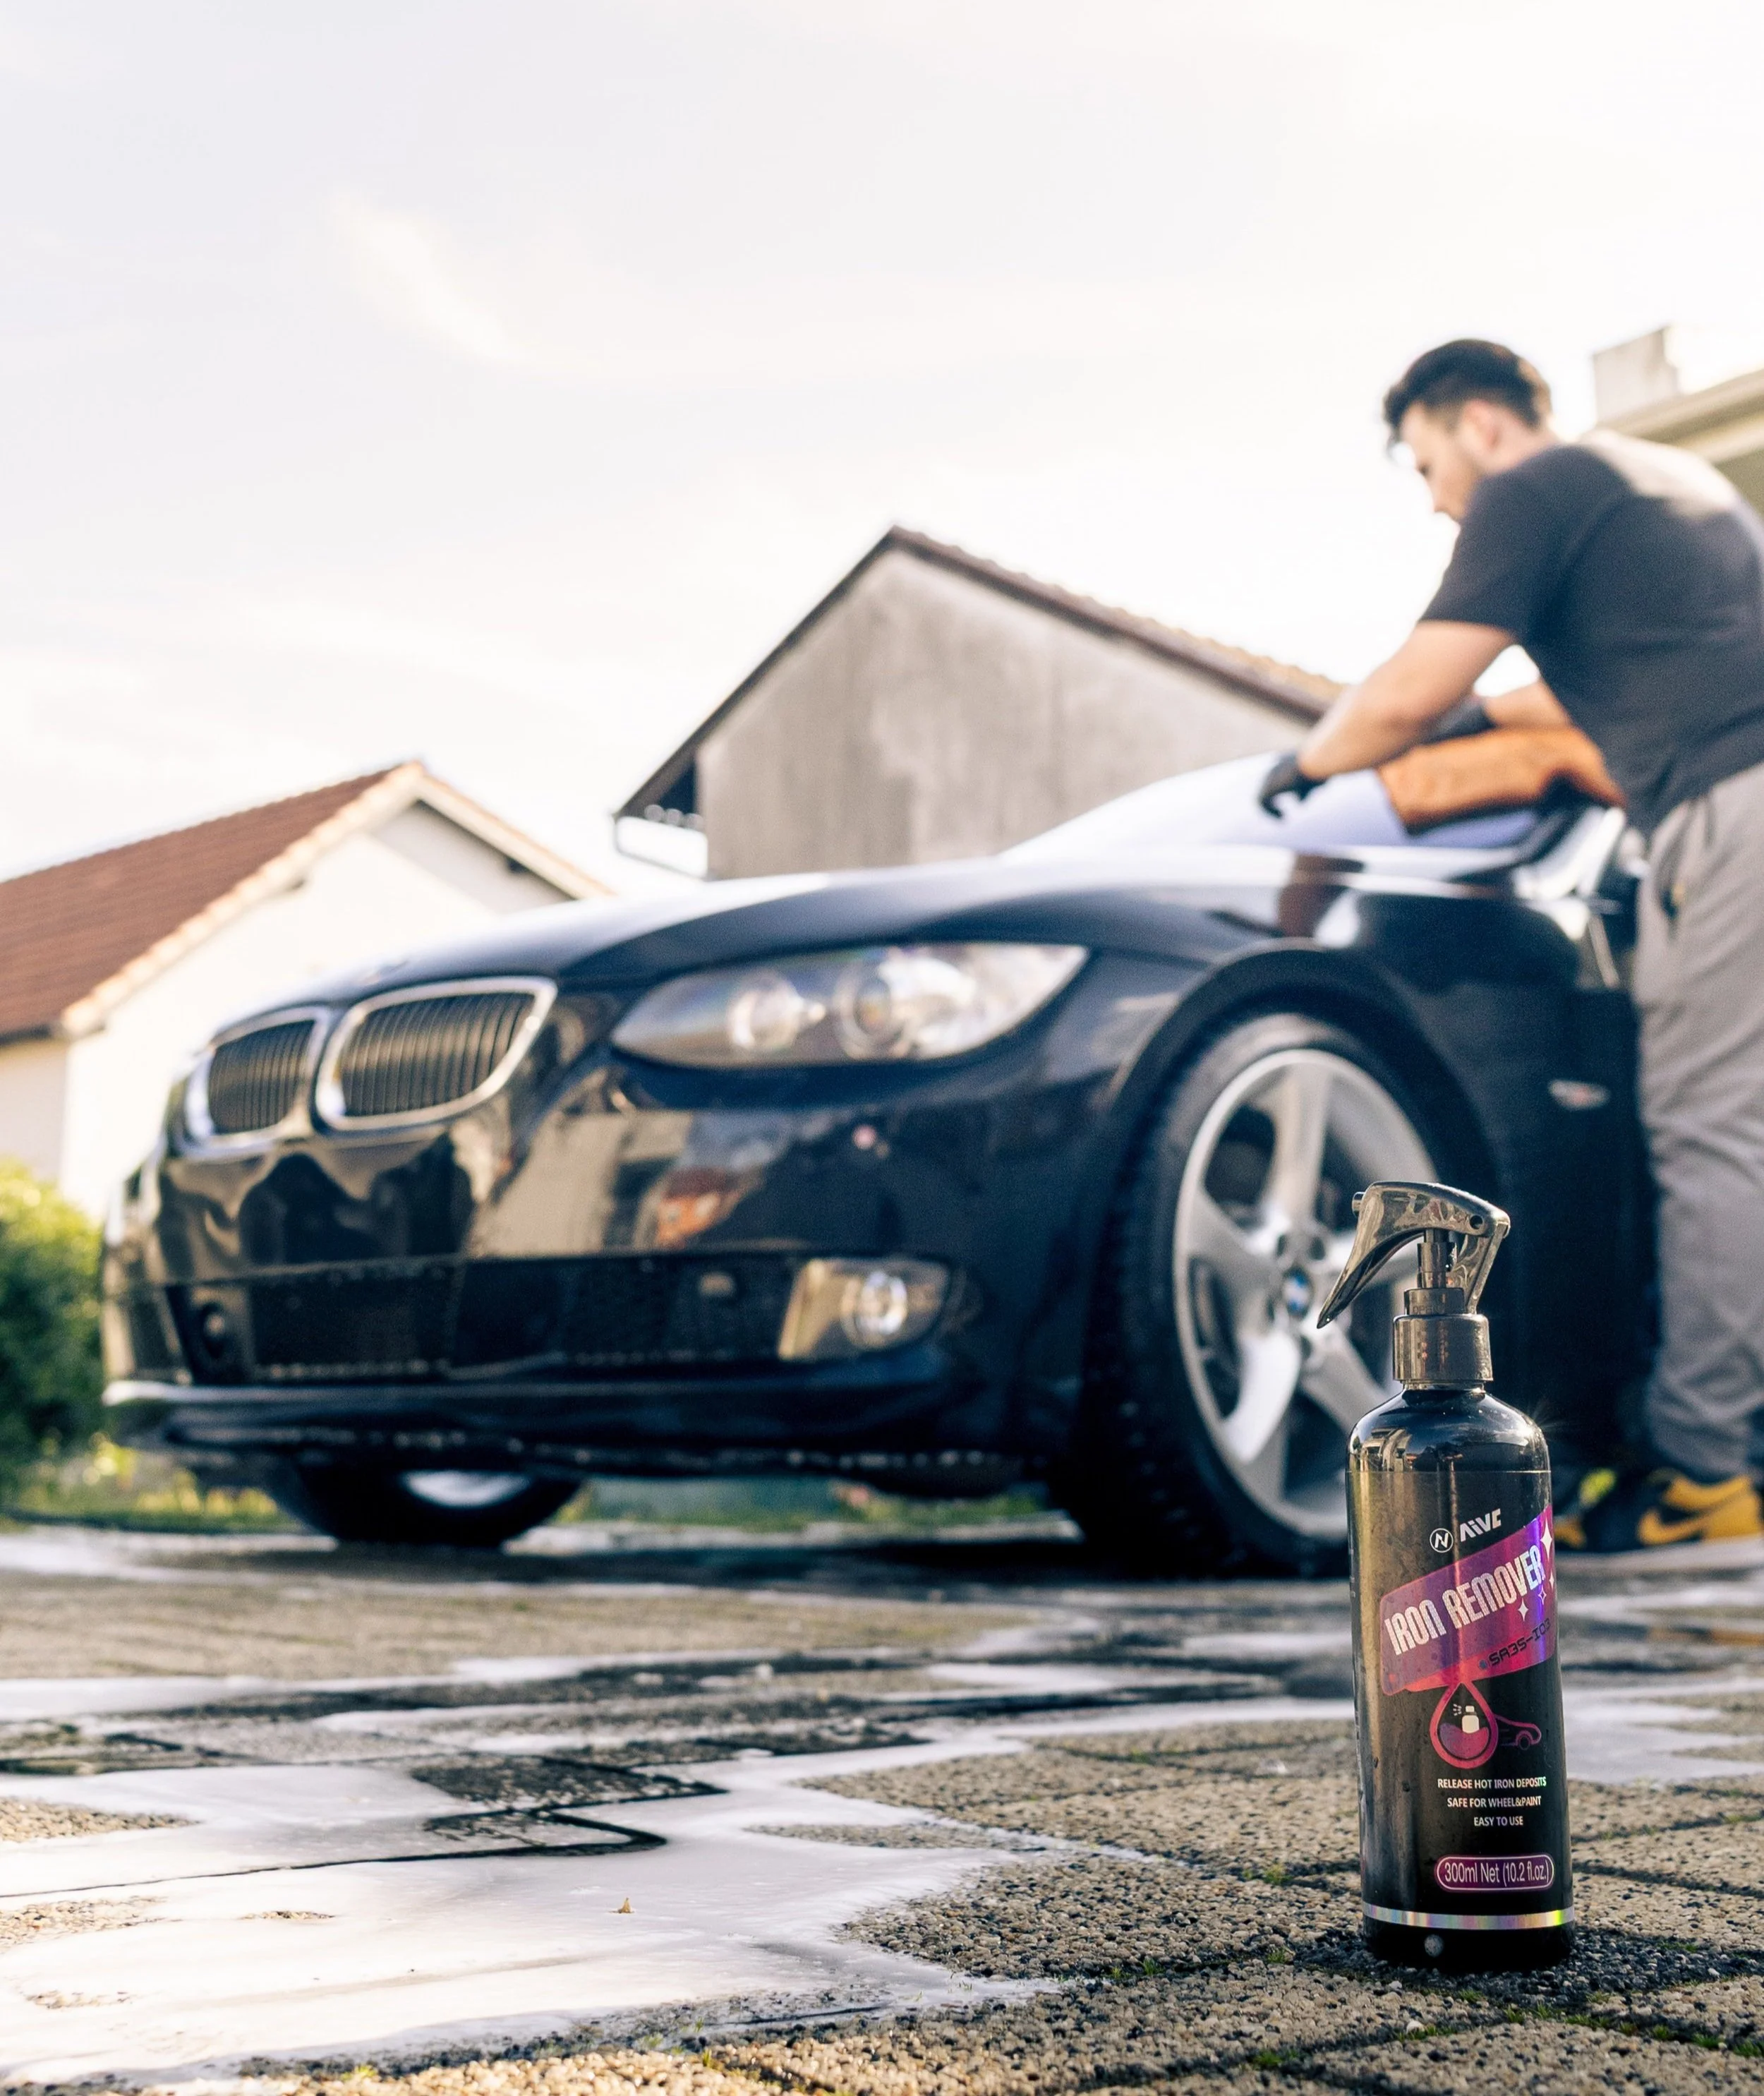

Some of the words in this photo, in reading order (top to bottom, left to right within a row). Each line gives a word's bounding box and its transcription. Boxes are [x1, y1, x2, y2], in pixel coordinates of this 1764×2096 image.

[1384, 1599, 1447, 1656] IRON
[1442, 1544, 1545, 1630] REMOVER
[1437, 1778, 1473, 1789] RELEASE
[1474, 1779, 1492, 1789] HOT
[1494, 1778, 1515, 1789] IRON
[1516, 1776, 1547, 1788] DEPOSITS
[1447, 1797, 1468, 1808] SAFE
[1469, 1797, 1487, 1808] FOR
[1488, 1795, 1542, 1808] WHEEL&PAINT
[1473, 1817, 1494, 1826] EASY
[1496, 1817, 1508, 1826] TO
[1509, 1816, 1524, 1826] USE
[1444, 1862, 1478, 1884] 300ml
[1480, 1862, 1500, 1884] Net
[1503, 1862, 1526, 1887] (10.2
